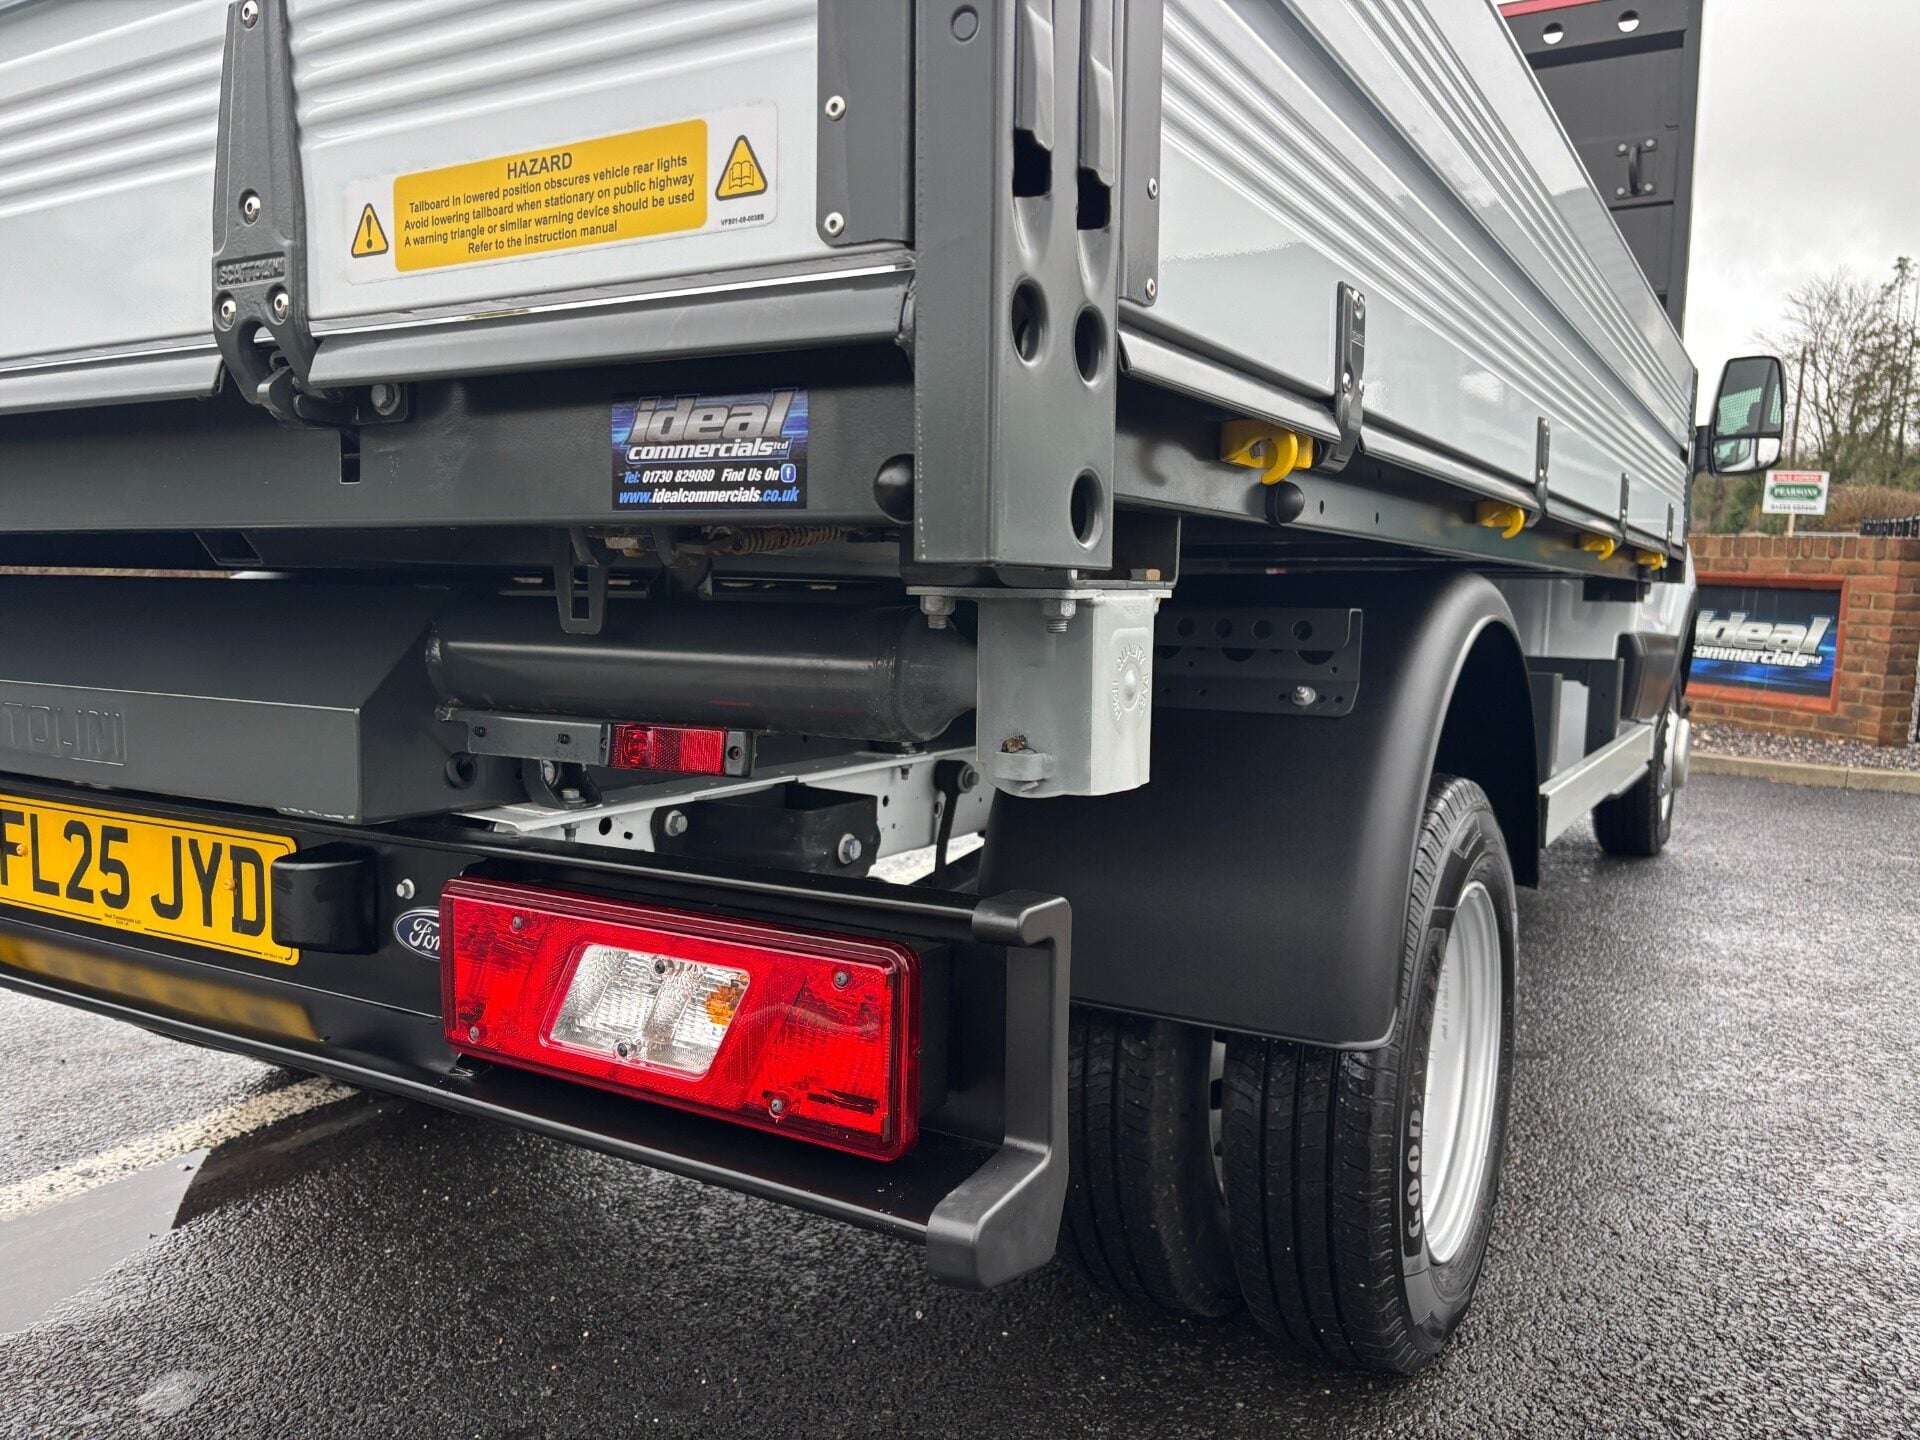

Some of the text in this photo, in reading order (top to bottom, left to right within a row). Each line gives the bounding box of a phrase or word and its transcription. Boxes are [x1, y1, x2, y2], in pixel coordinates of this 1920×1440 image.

[507, 152, 573, 180] HAZARD
[409, 155, 688, 213] Tailboard in lowered position obscures vehicle rear lights
[404, 173, 695, 231] Avoid lowering tailboard when stationary on public highway
[404, 189, 695, 248] A warning triangle or similar warning device should be used
[468, 220, 618, 254] Refer to the instruction manual
[627, 389, 798, 443] ideal
[628, 437, 774, 461] commercials
[624, 471, 641, 484] Tel:
[642, 470, 674, 484] 01730
[674, 468, 715, 483] 829080
[721, 467, 745, 482] Find
[748, 467, 762, 482] Us
[764, 467, 780, 482] On
[1774, 486, 1819, 498] PEARSONS
[619, 486, 800, 505] www.idealcommercials.co.uk
[0, 808, 266, 937] FL25 JYD
[408, 917, 440, 951] For
